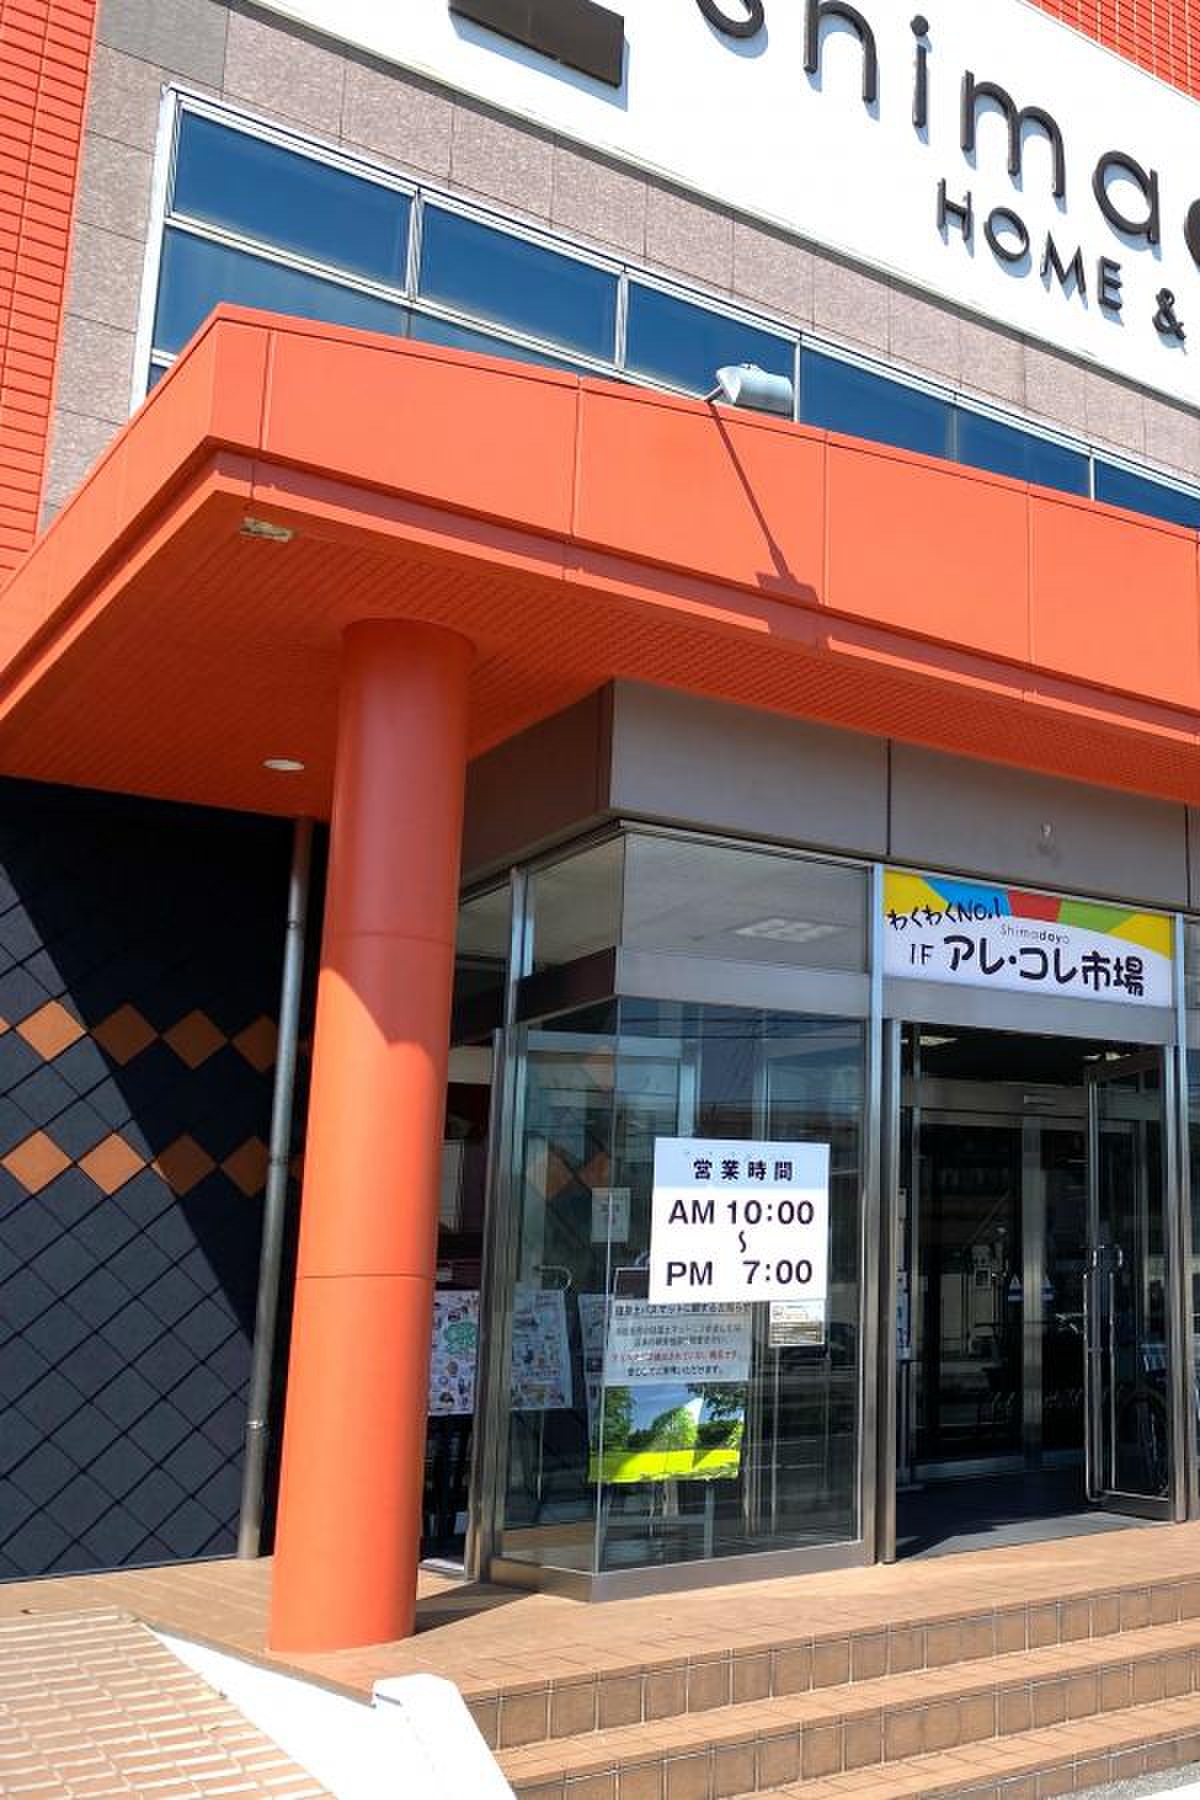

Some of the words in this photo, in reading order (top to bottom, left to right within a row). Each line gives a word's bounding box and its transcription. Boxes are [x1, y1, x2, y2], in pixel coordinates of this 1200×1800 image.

[937, 178, 1122, 310] HOME
[1152, 287, 1185, 341] &
[943, 935, 1145, 997] アレ・コレ市場
[692, 1158, 794, 1182] 営業時間
[668, 1199, 715, 1225] AM
[727, 1200, 815, 1225] 10:00
[666, 1261, 713, 1286] PM
[742, 1259, 813, 1285] 7:00
